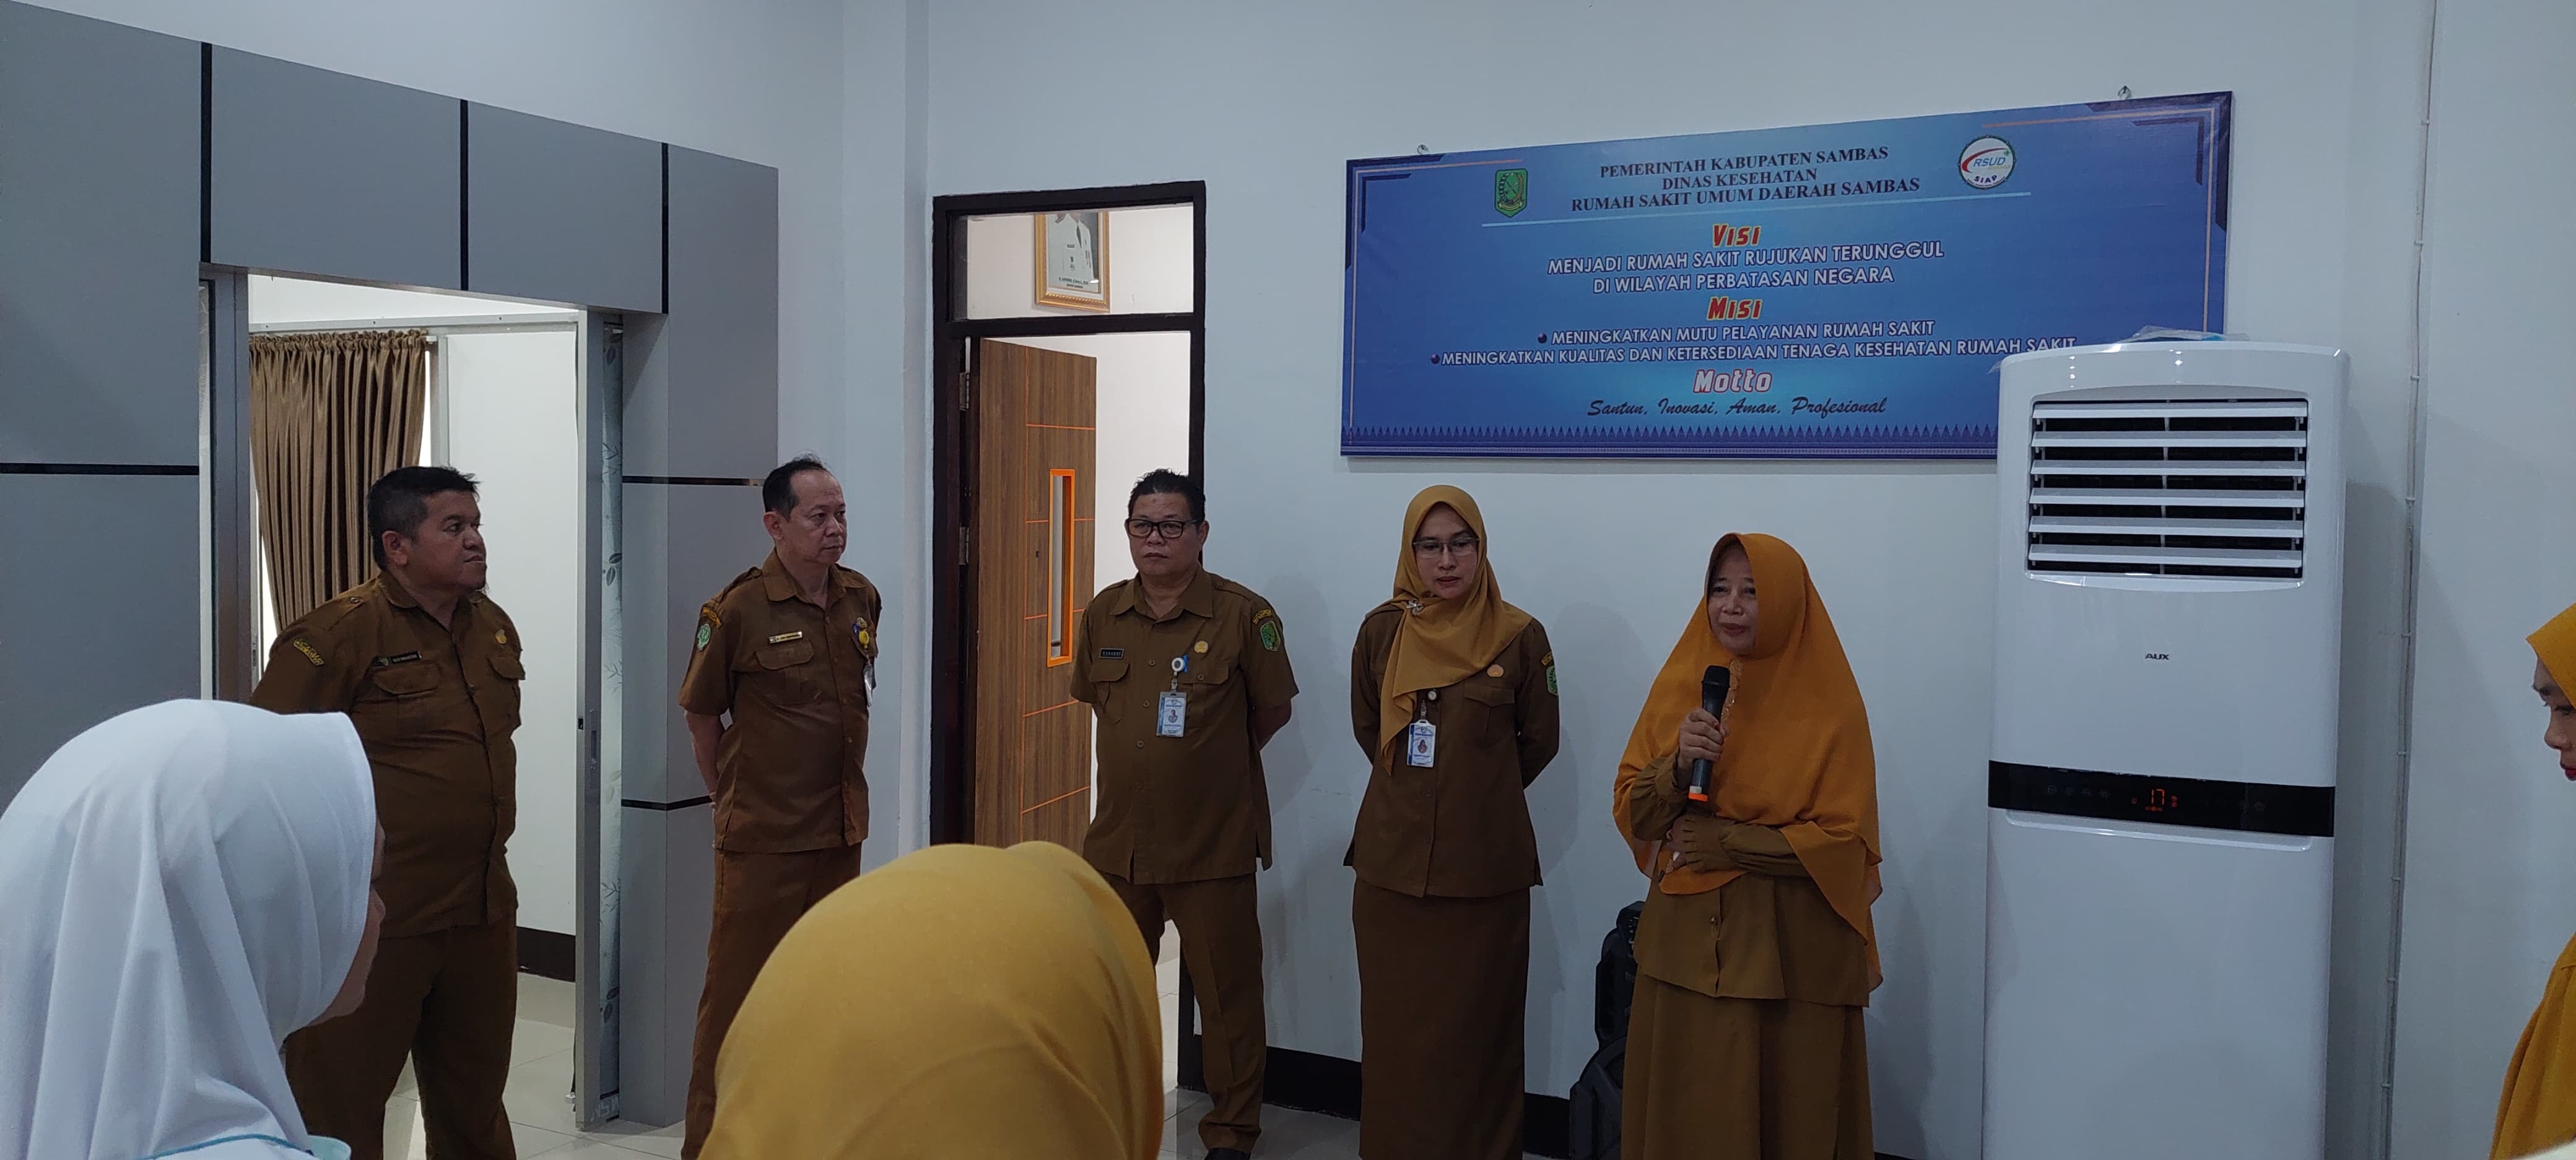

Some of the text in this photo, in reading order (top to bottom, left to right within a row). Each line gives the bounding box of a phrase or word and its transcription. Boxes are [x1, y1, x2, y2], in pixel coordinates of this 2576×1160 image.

[1601, 147, 1889, 178] PEMERINTAH KABUPATEN SAMBAS
[1973, 157, 2006, 168] RSUD
[1662, 168, 1817, 191] DINAS KESEHATAN
[1974, 175, 1998, 184] SIAP
[1572, 178, 1920, 212] RUMAH SAKIT UMUM DAERAH SAMBAS
[1547, 241, 1945, 274] MENJADI RUMAH SAKIT RUJUKAN TERUNGGUL
[1593, 266, 1895, 294] DI WILAYAH PERBATASAN NEGARA
[1551, 319, 1936, 345] MENINGKATKAN MUTU PELAYANAN RUMAH SAKIT
[1442, 337, 2077, 366] MENINGKATKAN KUALITAS DAN KETERSEDIAAN TENAGA KESEHATAN RUMAH SAKIT
[1693, 369, 1773, 394] Motto
[1586, 396, 1888, 419] Santun, Inovasi, Aman, Profesional
[2151, 788, 2165, 806] 17
